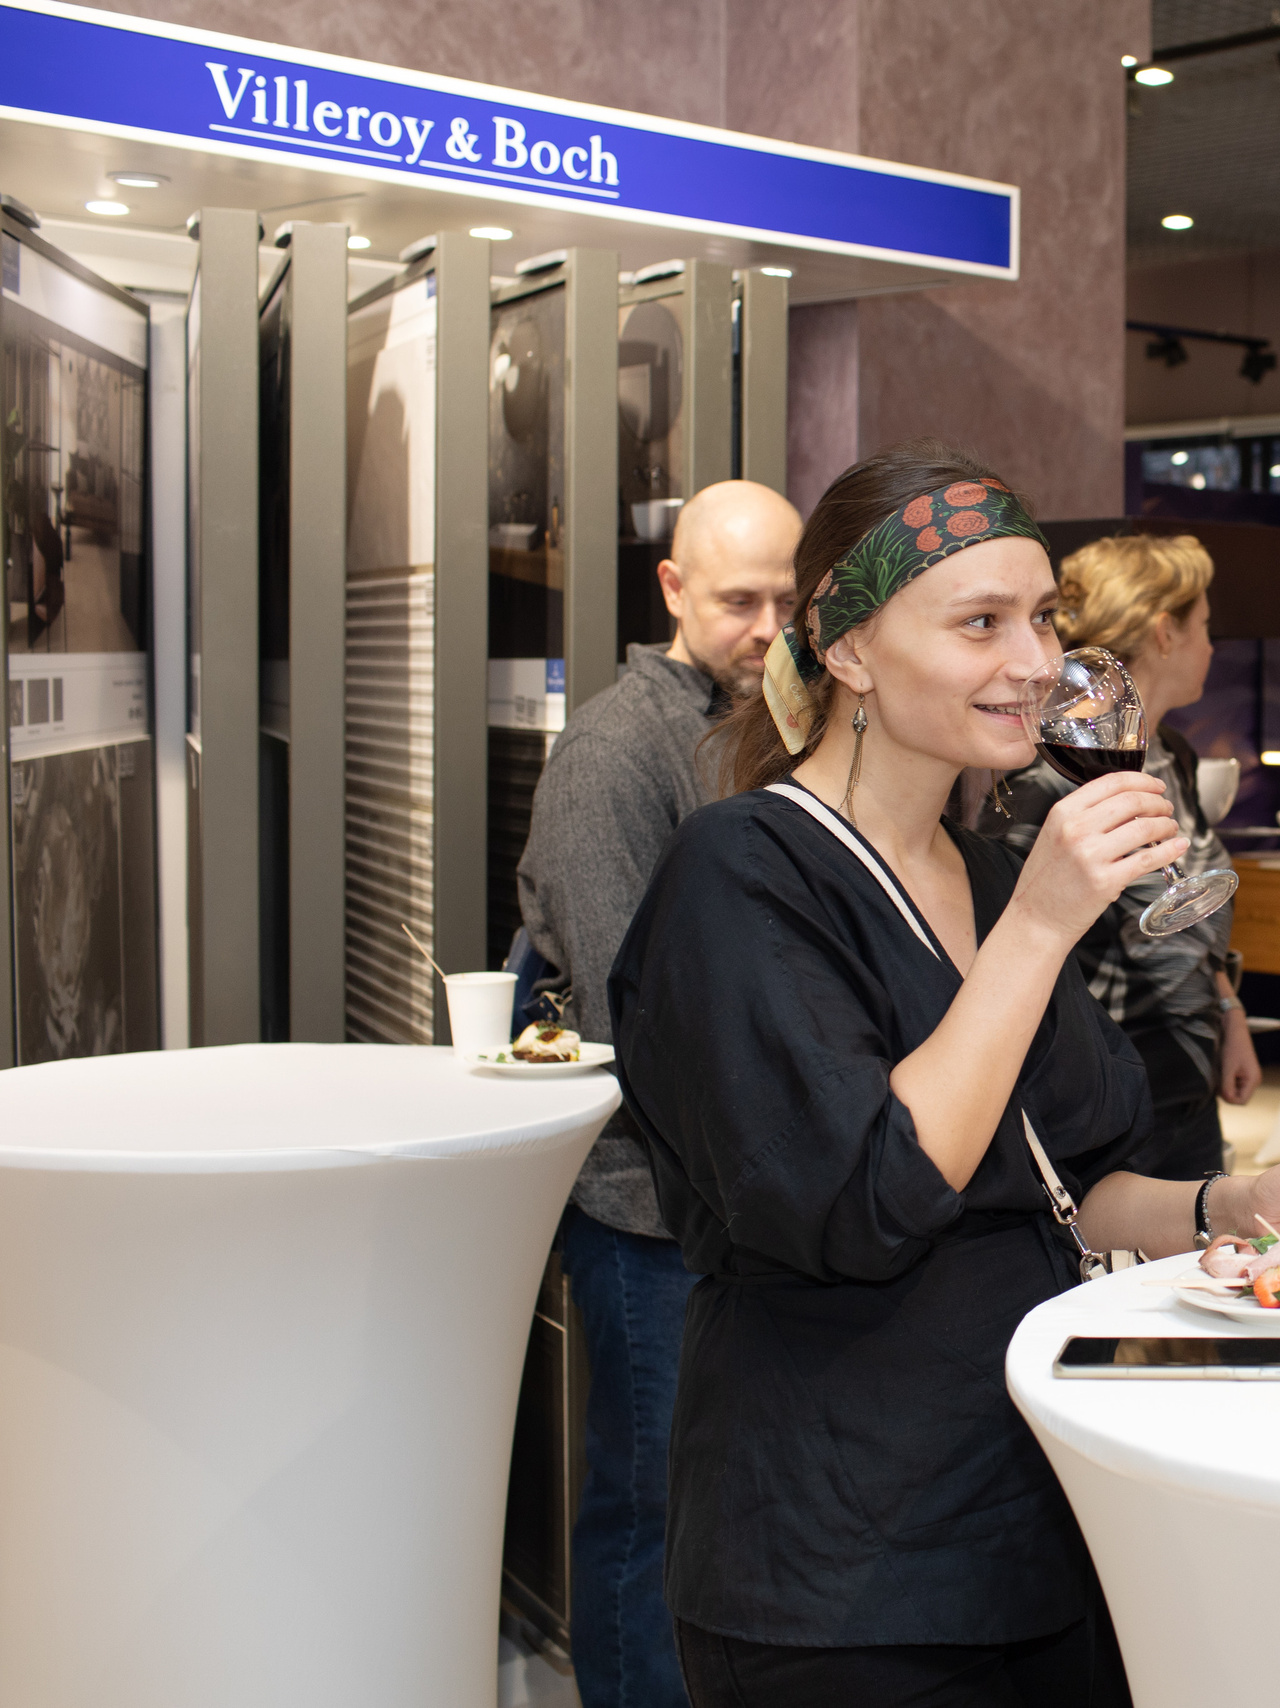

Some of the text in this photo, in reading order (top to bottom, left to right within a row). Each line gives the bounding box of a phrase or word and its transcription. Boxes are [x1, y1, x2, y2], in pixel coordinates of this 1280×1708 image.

[205, 61, 620, 186] Villeroy & Boch
